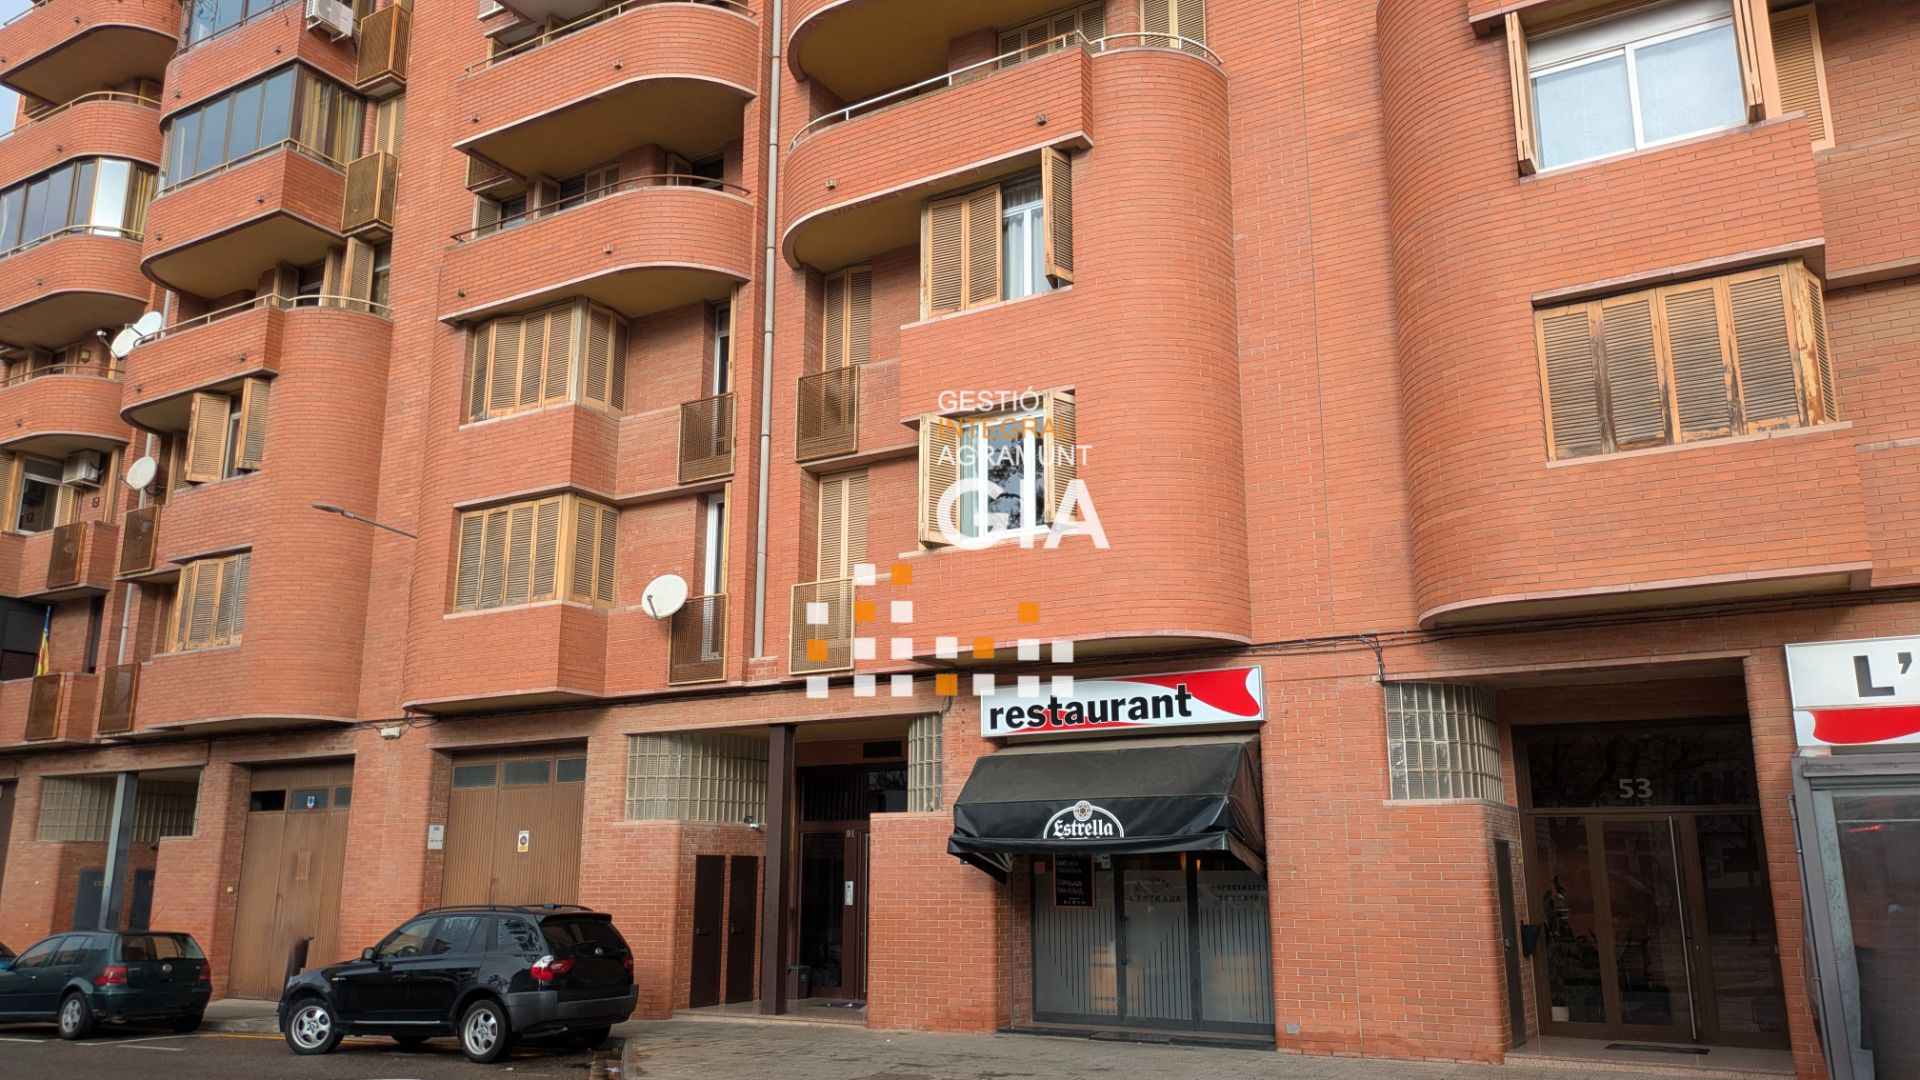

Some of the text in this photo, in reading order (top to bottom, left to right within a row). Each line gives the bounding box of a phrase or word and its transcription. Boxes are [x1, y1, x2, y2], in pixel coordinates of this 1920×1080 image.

[990, 684, 1192, 730] restaurant
[1618, 777, 1653, 799] 53
[1052, 819, 1114, 837] Estrella
